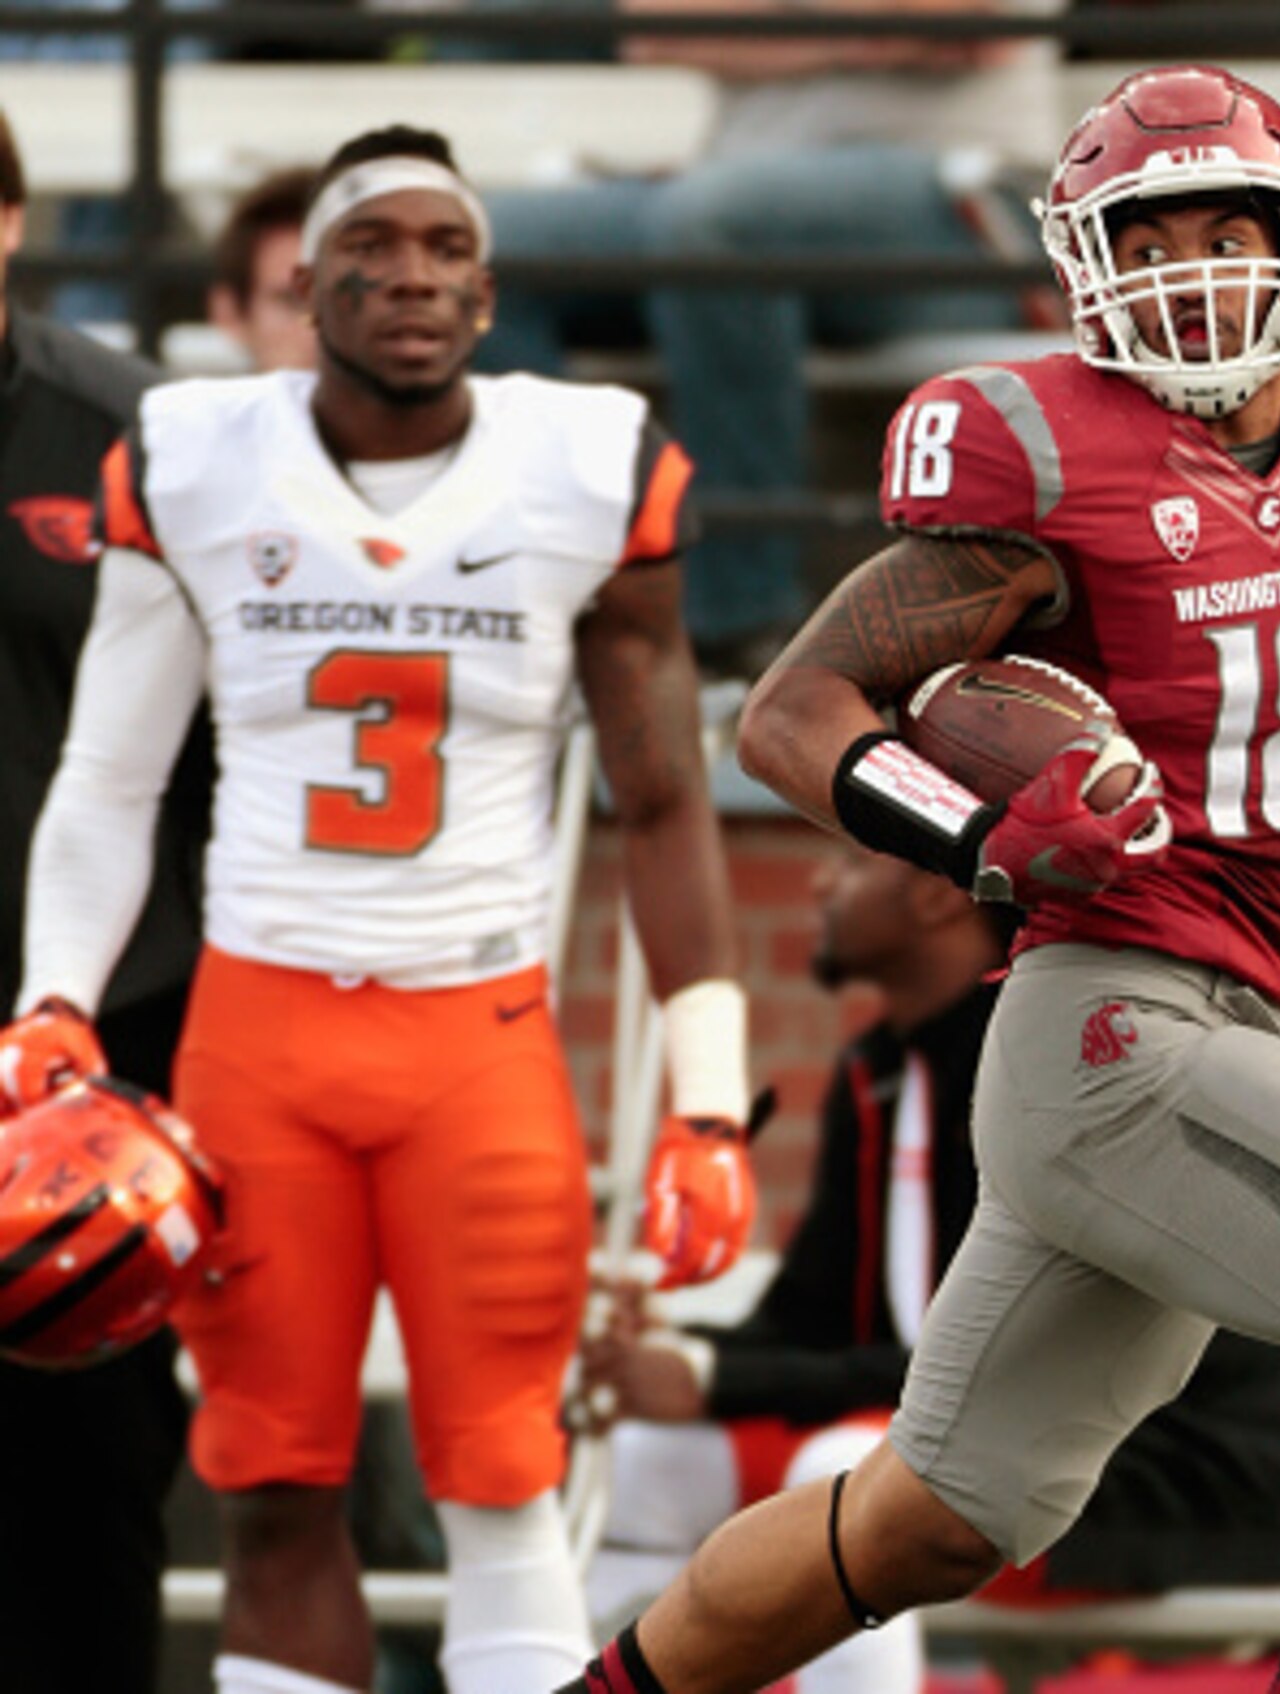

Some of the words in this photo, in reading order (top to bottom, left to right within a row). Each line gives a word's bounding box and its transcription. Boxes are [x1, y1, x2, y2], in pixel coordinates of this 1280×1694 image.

[890, 401, 961, 499] 18
[240, 601, 396, 632] OREGON
[406, 604, 528, 641] STATE
[304, 646, 453, 858] 3
